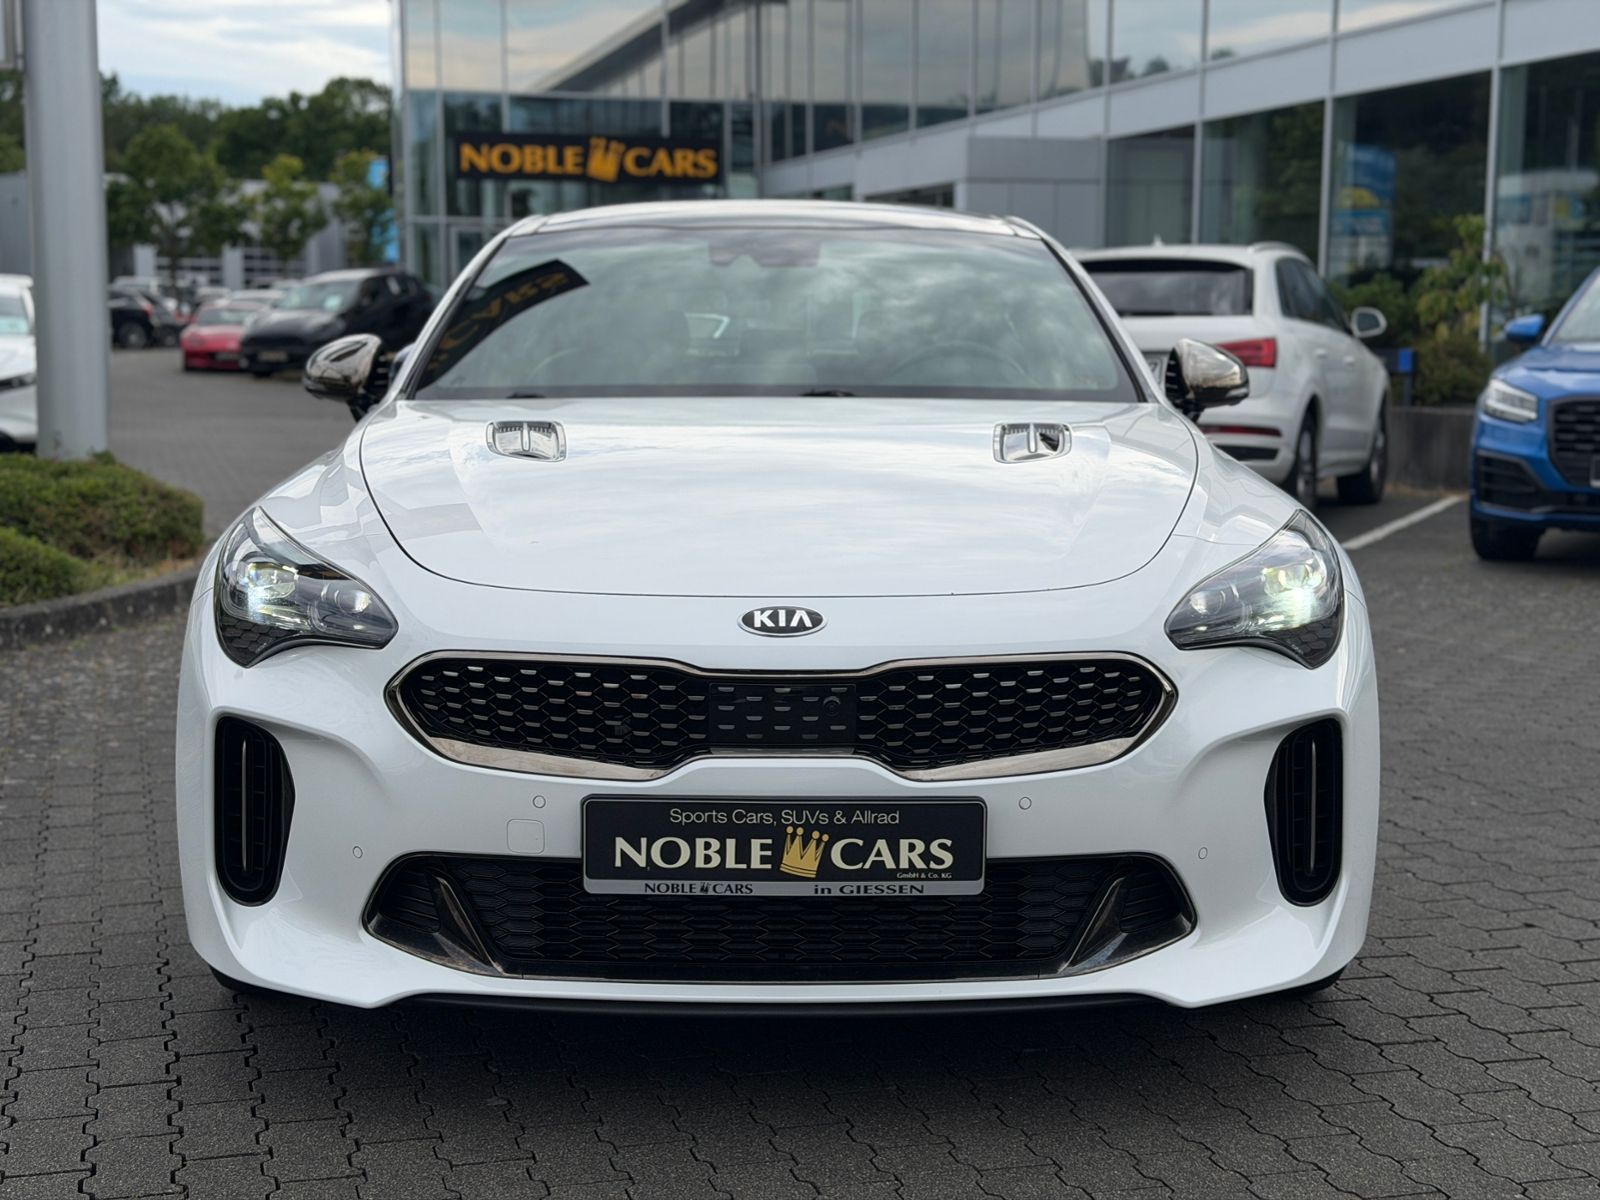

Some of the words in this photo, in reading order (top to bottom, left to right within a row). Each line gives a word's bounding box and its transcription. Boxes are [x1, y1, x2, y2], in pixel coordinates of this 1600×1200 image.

[459, 142, 584, 174] NOBLE
[623, 147, 718, 177] CARS
[753, 609, 813, 628] KIA
[669, 808, 728, 825] Sports
[731, 809, 777, 826] Cars,
[780, 809, 829, 825] SUVs
[833, 810, 847, 825] &
[850, 810, 901, 825] Allrad
[613, 836, 773, 870] NOBLE
[829, 838, 954, 870] CARS
[644, 883, 697, 894] NOBLE
[712, 883, 753, 895] CARS
[814, 884, 832, 895] in
[839, 884, 925, 895] GIESSEN
